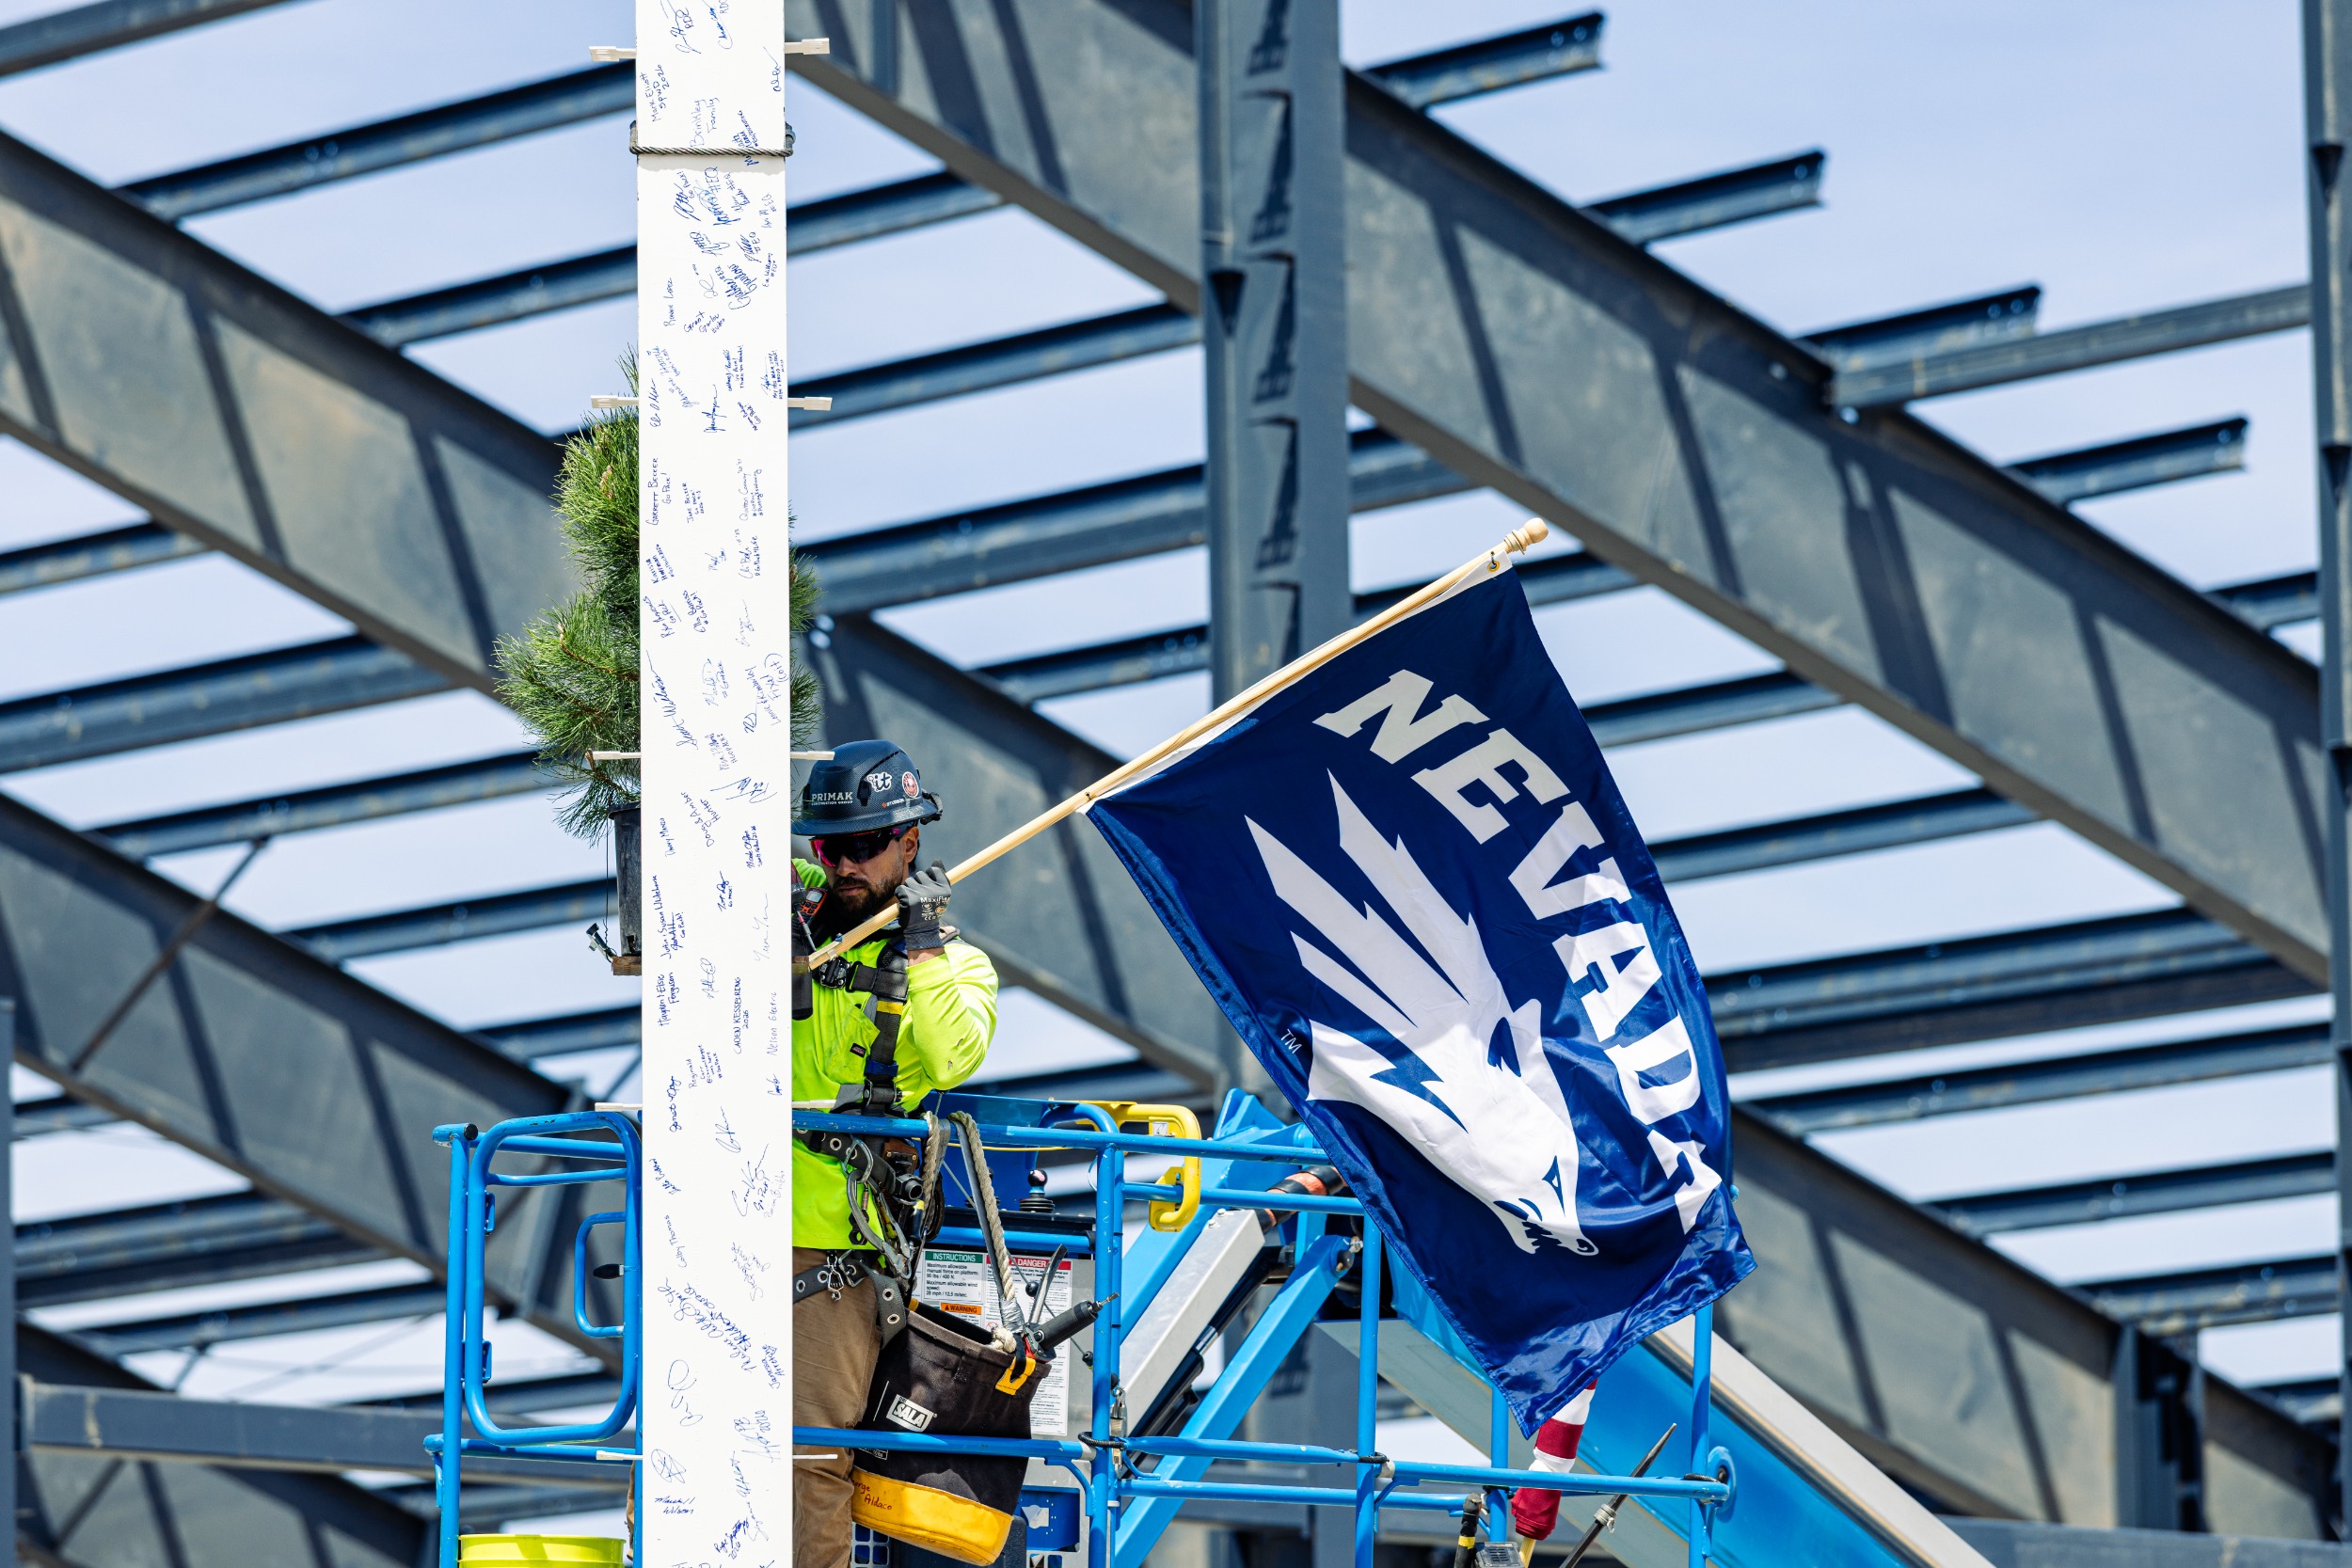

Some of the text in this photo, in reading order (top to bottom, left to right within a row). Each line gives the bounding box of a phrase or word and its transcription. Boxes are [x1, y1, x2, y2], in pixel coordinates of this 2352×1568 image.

[655, 65, 669, 89] 2026
[649, 100, 660, 121] Mark
[707, 98, 719, 133] Family
[690, 100, 707, 147] Brinkley
[681, 792, 701, 816] Amber
[811, 791, 853, 801] PRIMAK
[700, 799, 721, 823] Hunter
[700, 820, 715, 847] Doug
[1311, 669, 1723, 1235] NEVADA
[668, 973, 679, 1004] Ferguson
[1280, 1028, 1303, 1054] TM
[686, 1059, 697, 1088] Reginald
[664, 1215, 677, 1245] Thomas
[932, 1252, 977, 1262] INSTRUCTIONS
[1017, 1259, 1046, 1268] DANGER
[949, 1305, 977, 1313] WARNING
[762, 1358, 780, 1388] Janessa
[893, 1402, 926, 1428] SALA
[851, 1480, 871, 1495] eorge
[864, 1493, 893, 1511] Aldaco
